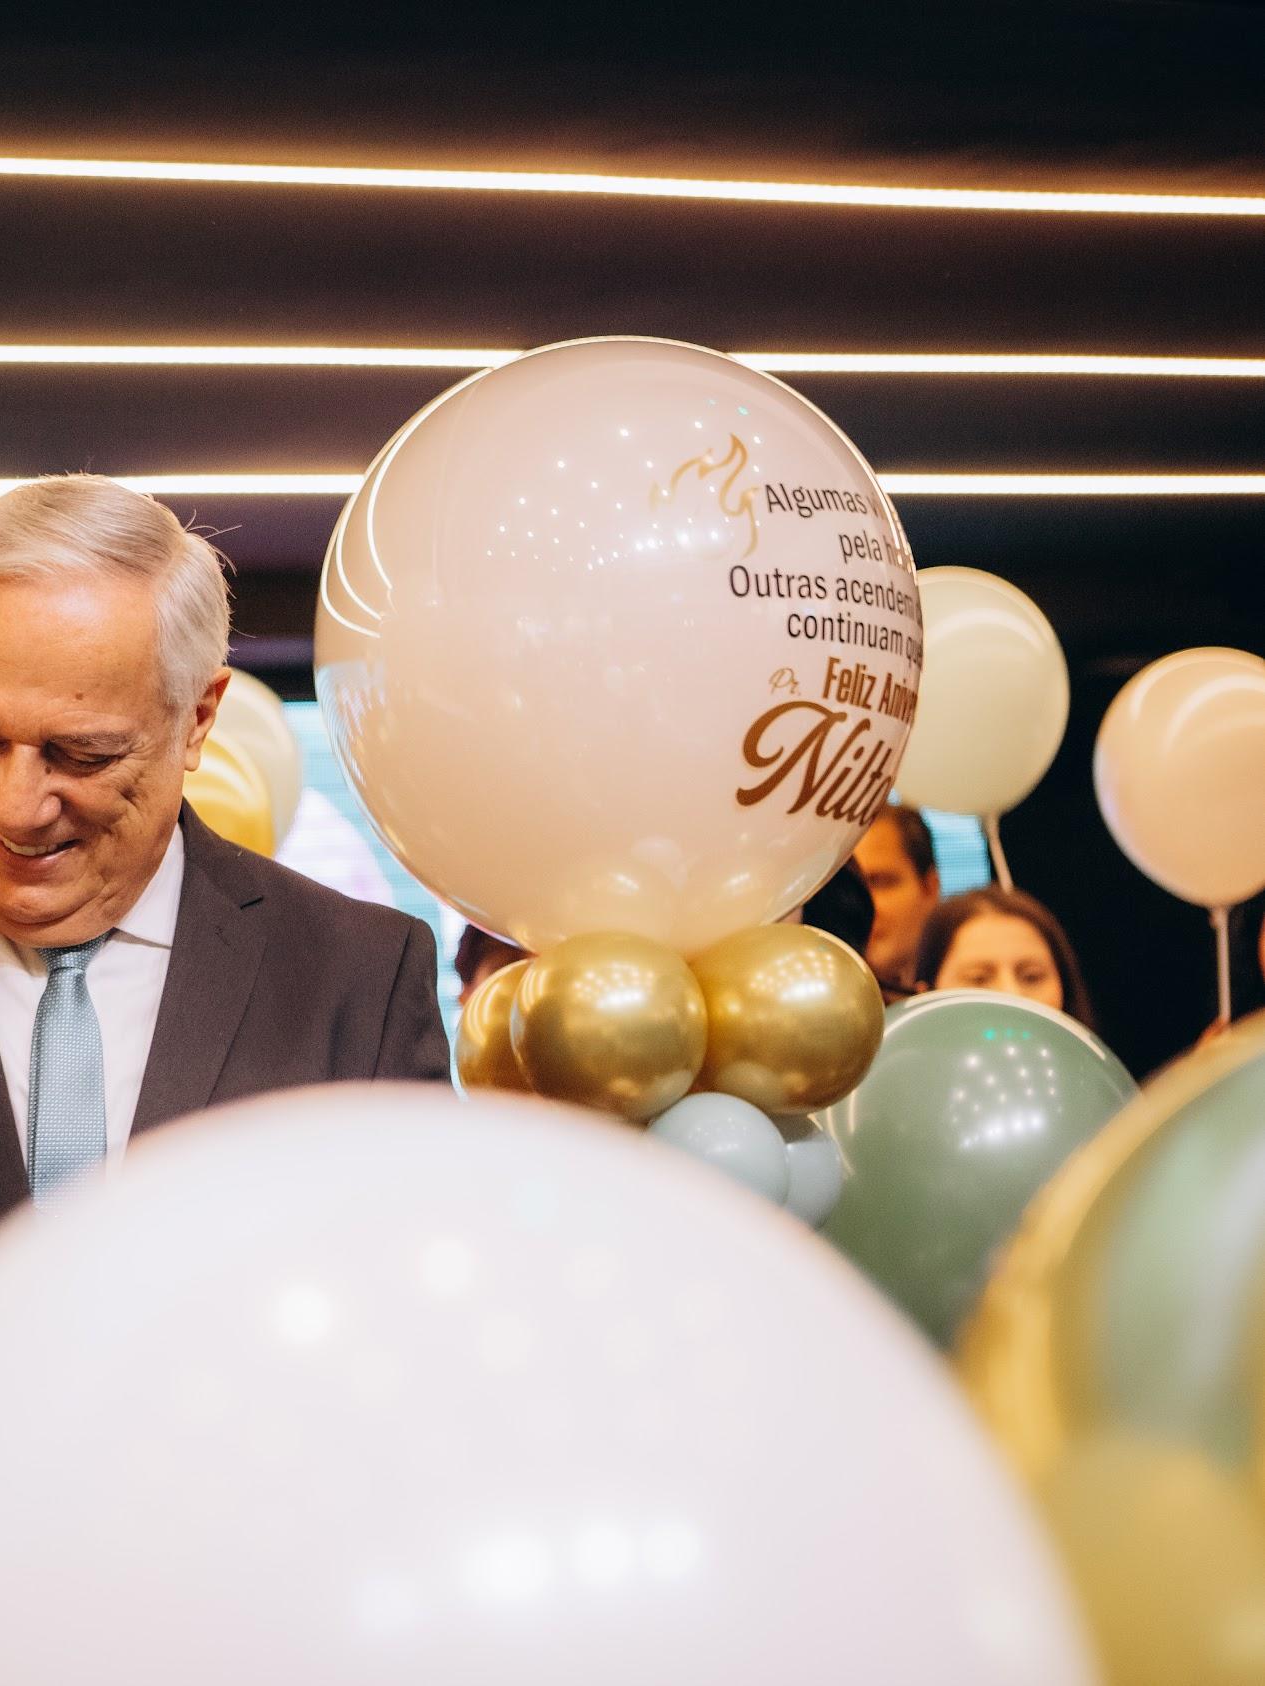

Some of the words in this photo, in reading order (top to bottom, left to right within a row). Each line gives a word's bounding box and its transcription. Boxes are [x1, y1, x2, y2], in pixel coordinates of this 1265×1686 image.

[764, 483, 867, 519] Algumas
[839, 529, 883, 564] pela
[729, 565, 827, 599] Outras
[787, 612, 903, 656] continuam
[823, 656, 877, 710] Feliz
